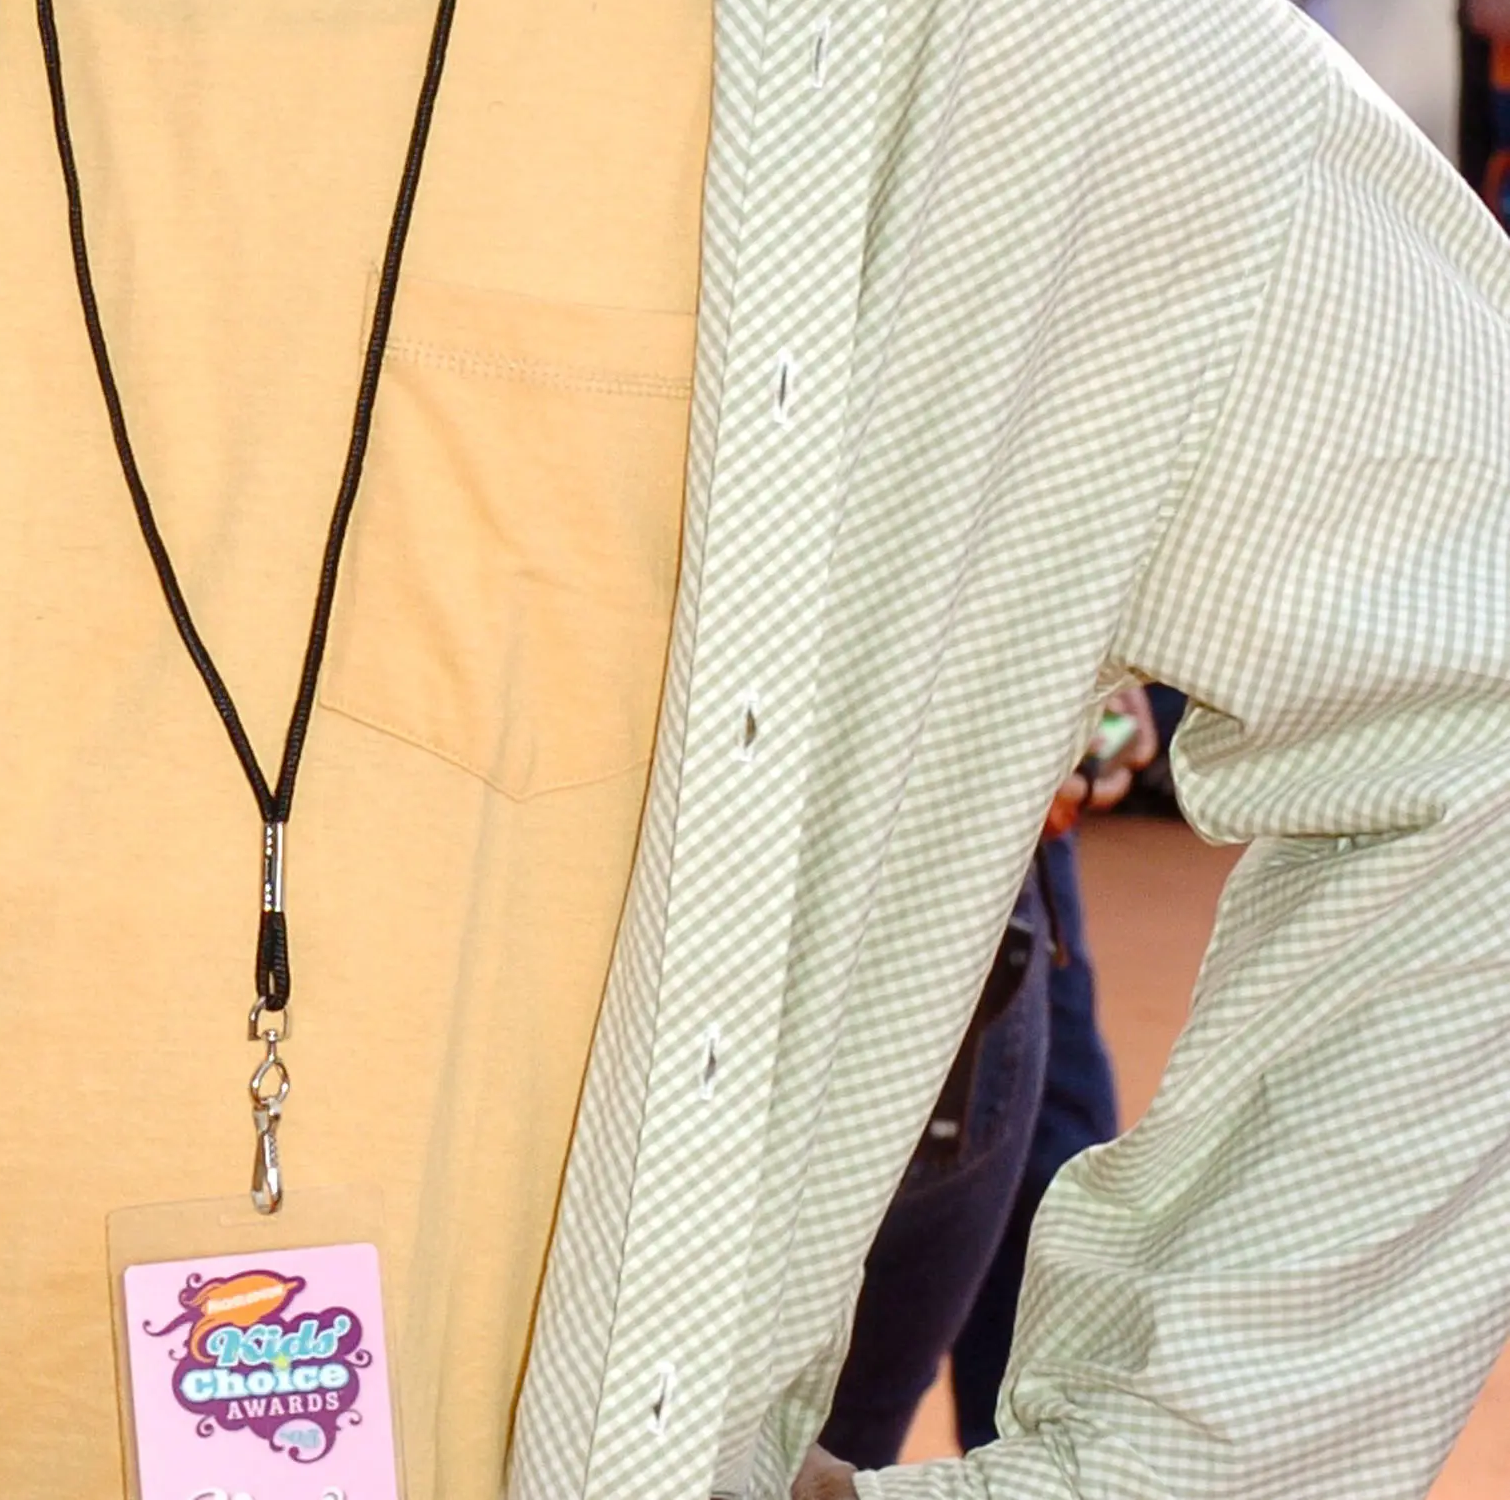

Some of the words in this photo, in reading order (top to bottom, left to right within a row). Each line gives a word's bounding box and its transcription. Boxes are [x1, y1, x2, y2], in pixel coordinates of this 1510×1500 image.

[208, 1316, 351, 1366] Kids'
[180, 1364, 350, 1402] Choice
[227, 1392, 340, 1420] AWARDS
